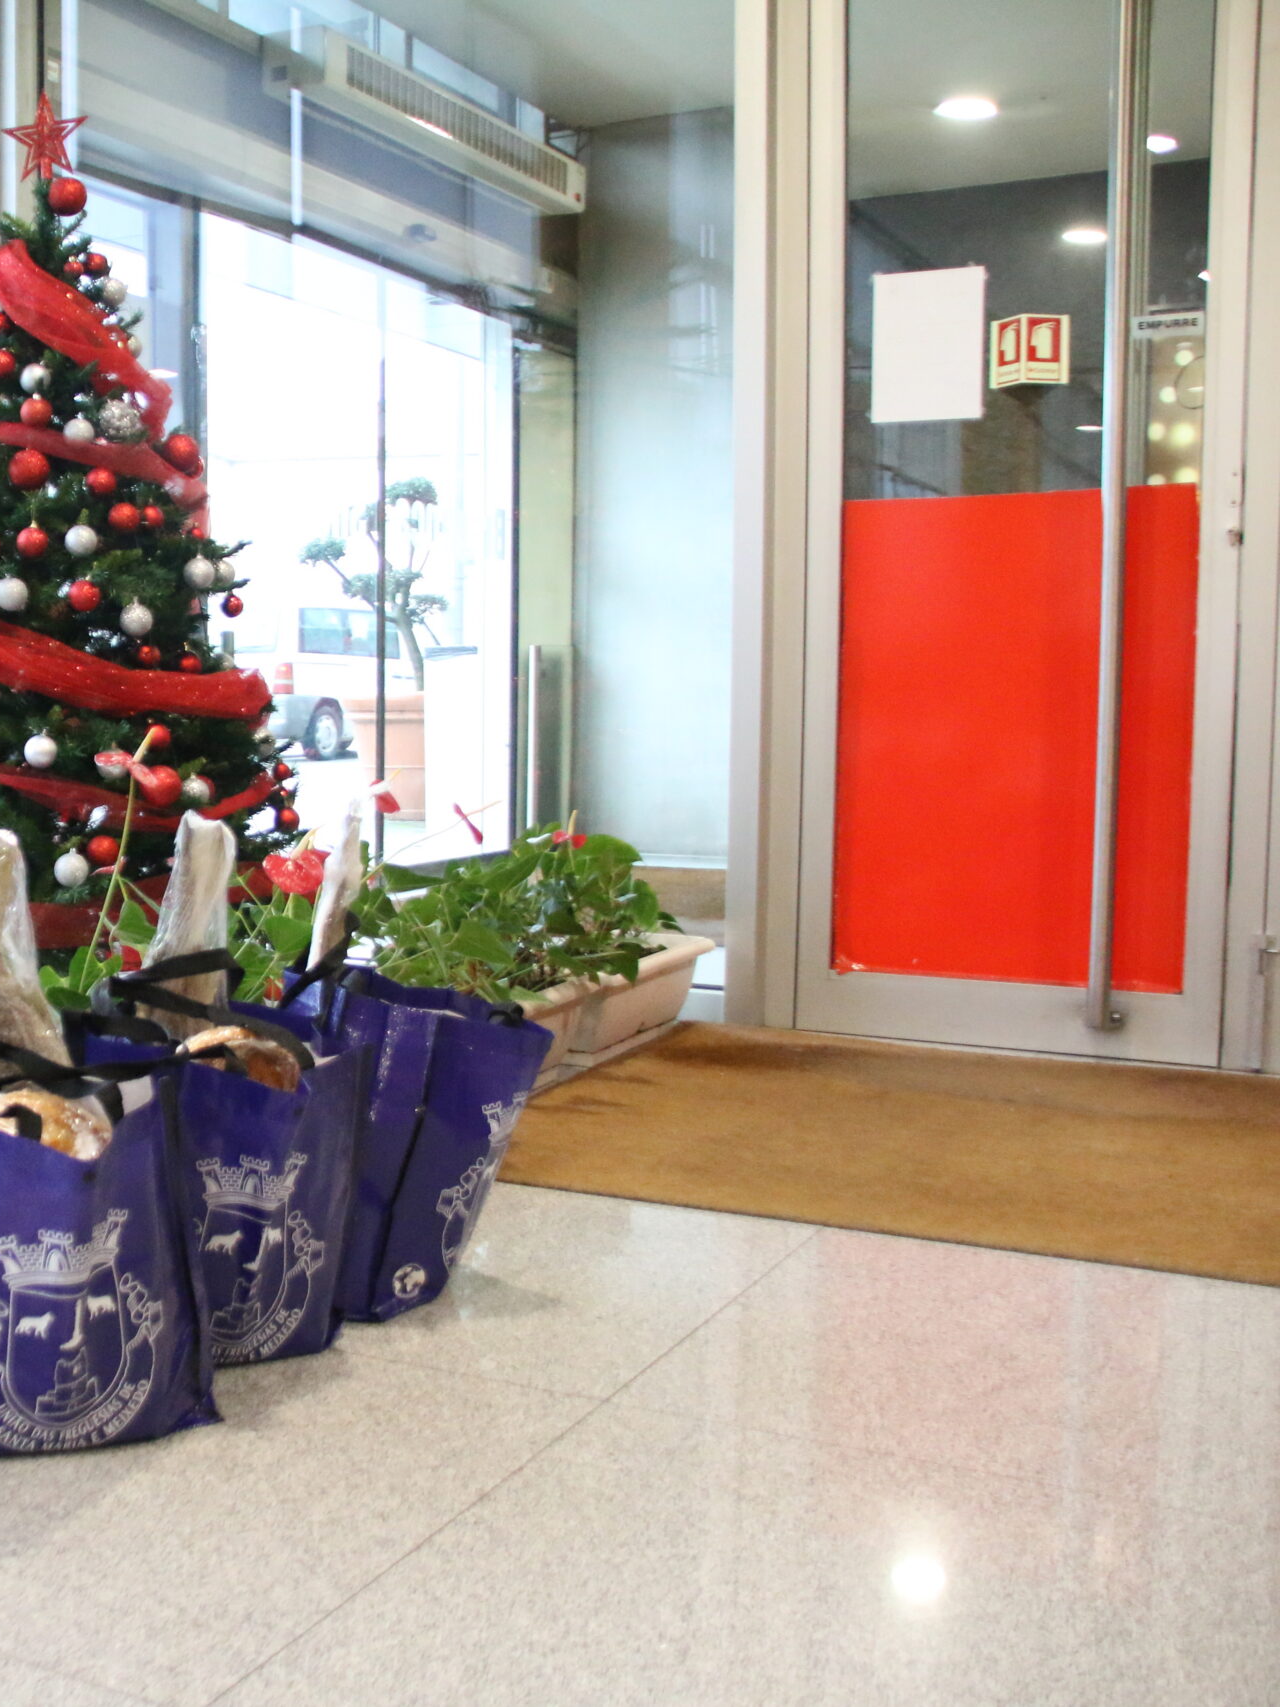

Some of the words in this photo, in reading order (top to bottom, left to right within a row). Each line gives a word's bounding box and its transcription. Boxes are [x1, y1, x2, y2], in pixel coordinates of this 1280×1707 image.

[1137, 317, 1198, 330] EMPURRE
[260, 1309, 302, 1357] MEIXEDO
[275, 1308, 289, 1324] DE
[30, 1427, 56, 1441] DAS
[59, 1398, 123, 1441] FREGUESIAS
[119, 1381, 137, 1401] DE
[42, 1437, 89, 1452] MARIA
[91, 1429, 103, 1443] E
[102, 1379, 151, 1434] MEIXEDO
